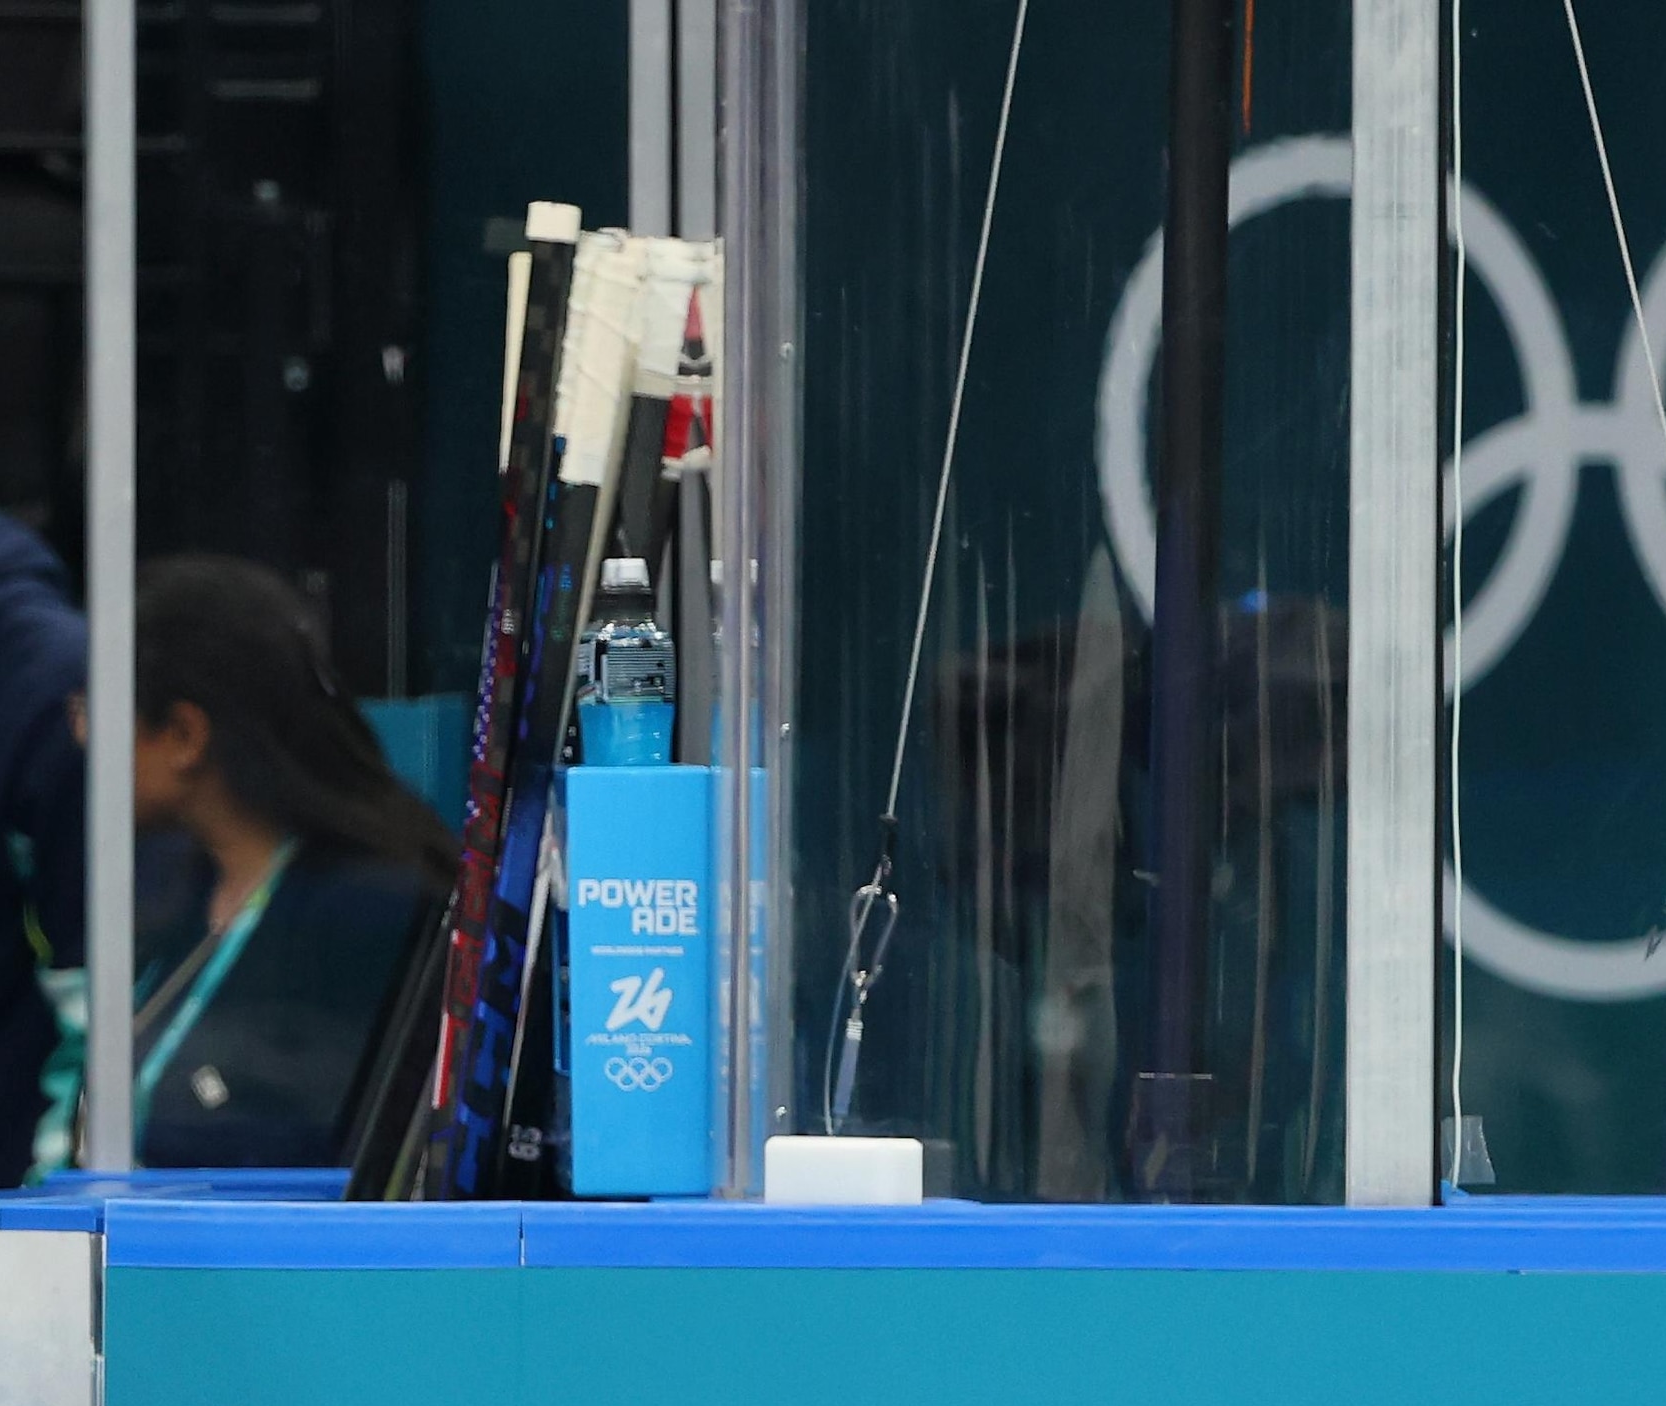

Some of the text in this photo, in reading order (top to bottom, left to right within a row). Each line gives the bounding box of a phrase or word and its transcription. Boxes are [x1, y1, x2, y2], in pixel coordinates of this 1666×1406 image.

[577, 878, 698, 909] POWER
[631, 905, 699, 936] ADE
[604, 966, 674, 1032] 26
